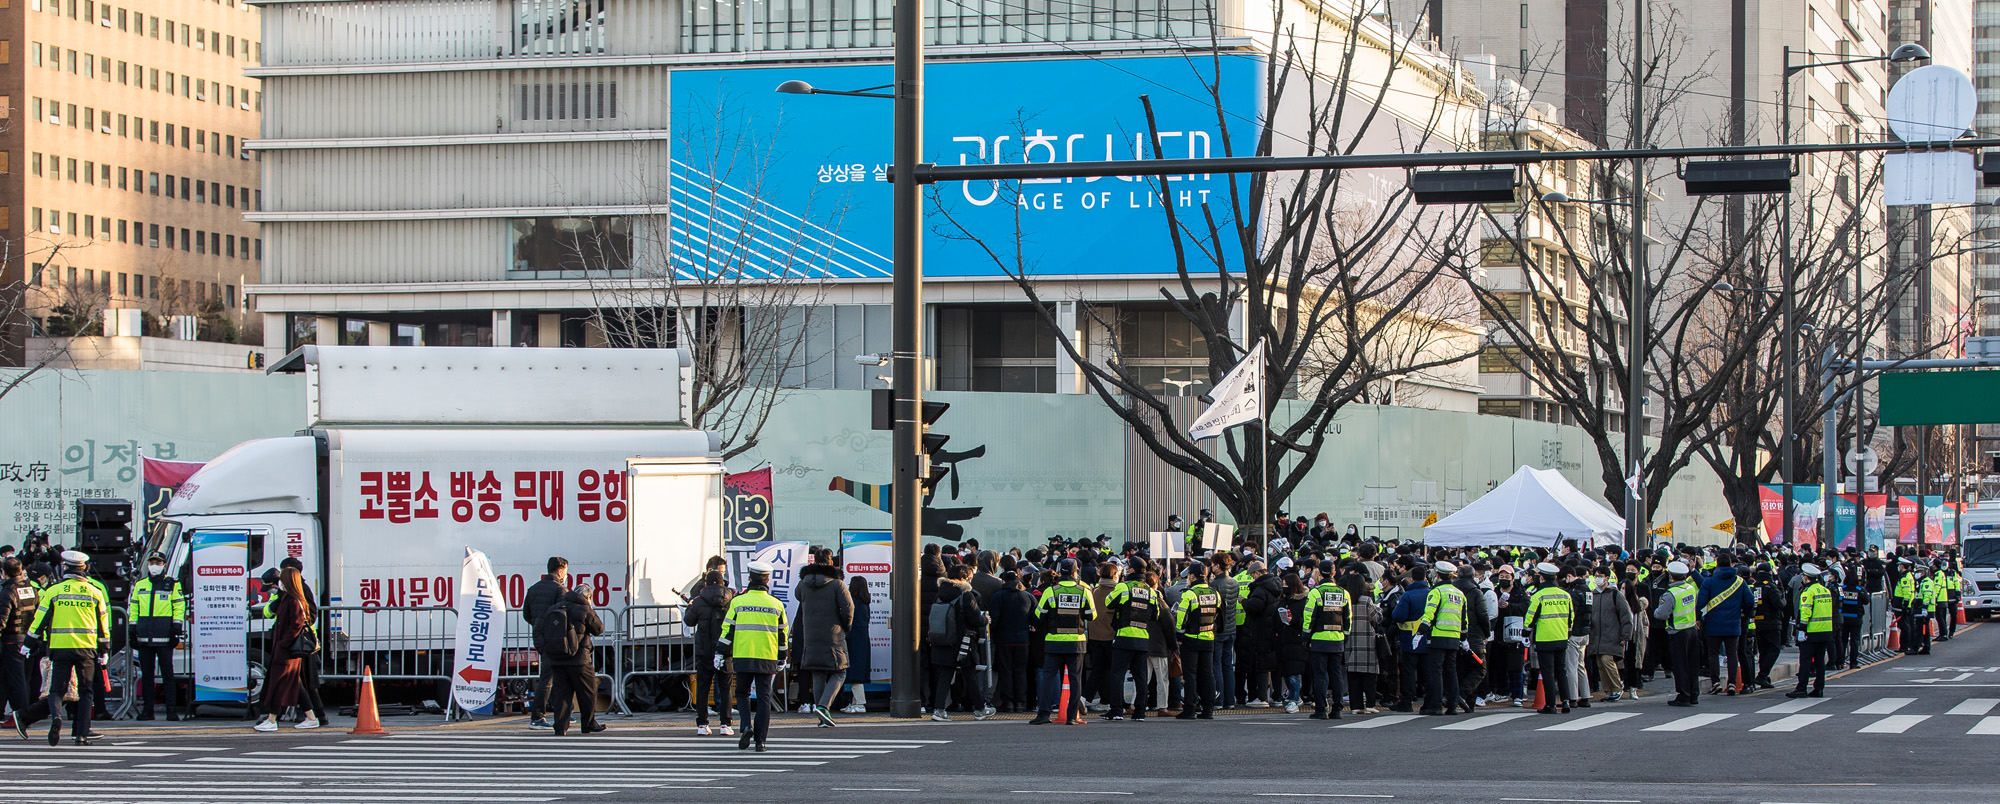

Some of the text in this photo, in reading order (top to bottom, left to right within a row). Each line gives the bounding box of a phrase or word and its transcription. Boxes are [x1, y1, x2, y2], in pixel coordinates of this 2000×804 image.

[817, 163, 894, 182] 상상을 실
[1017, 193, 1063, 210] AGE
[1081, 191, 1111, 209] OF
[14, 488, 40, 498] 백관을
[359, 471, 439, 523] 코뿔소
[450, 470, 502, 523] 방송
[513, 470, 563, 522] 무대
[14, 512, 40, 522] 음양을
[359, 576, 454, 614] 행사문의
[58, 600, 92, 608] POLICE
[742, 606, 774, 614] POLICE
[1508, 628, 1523, 637] NIK
